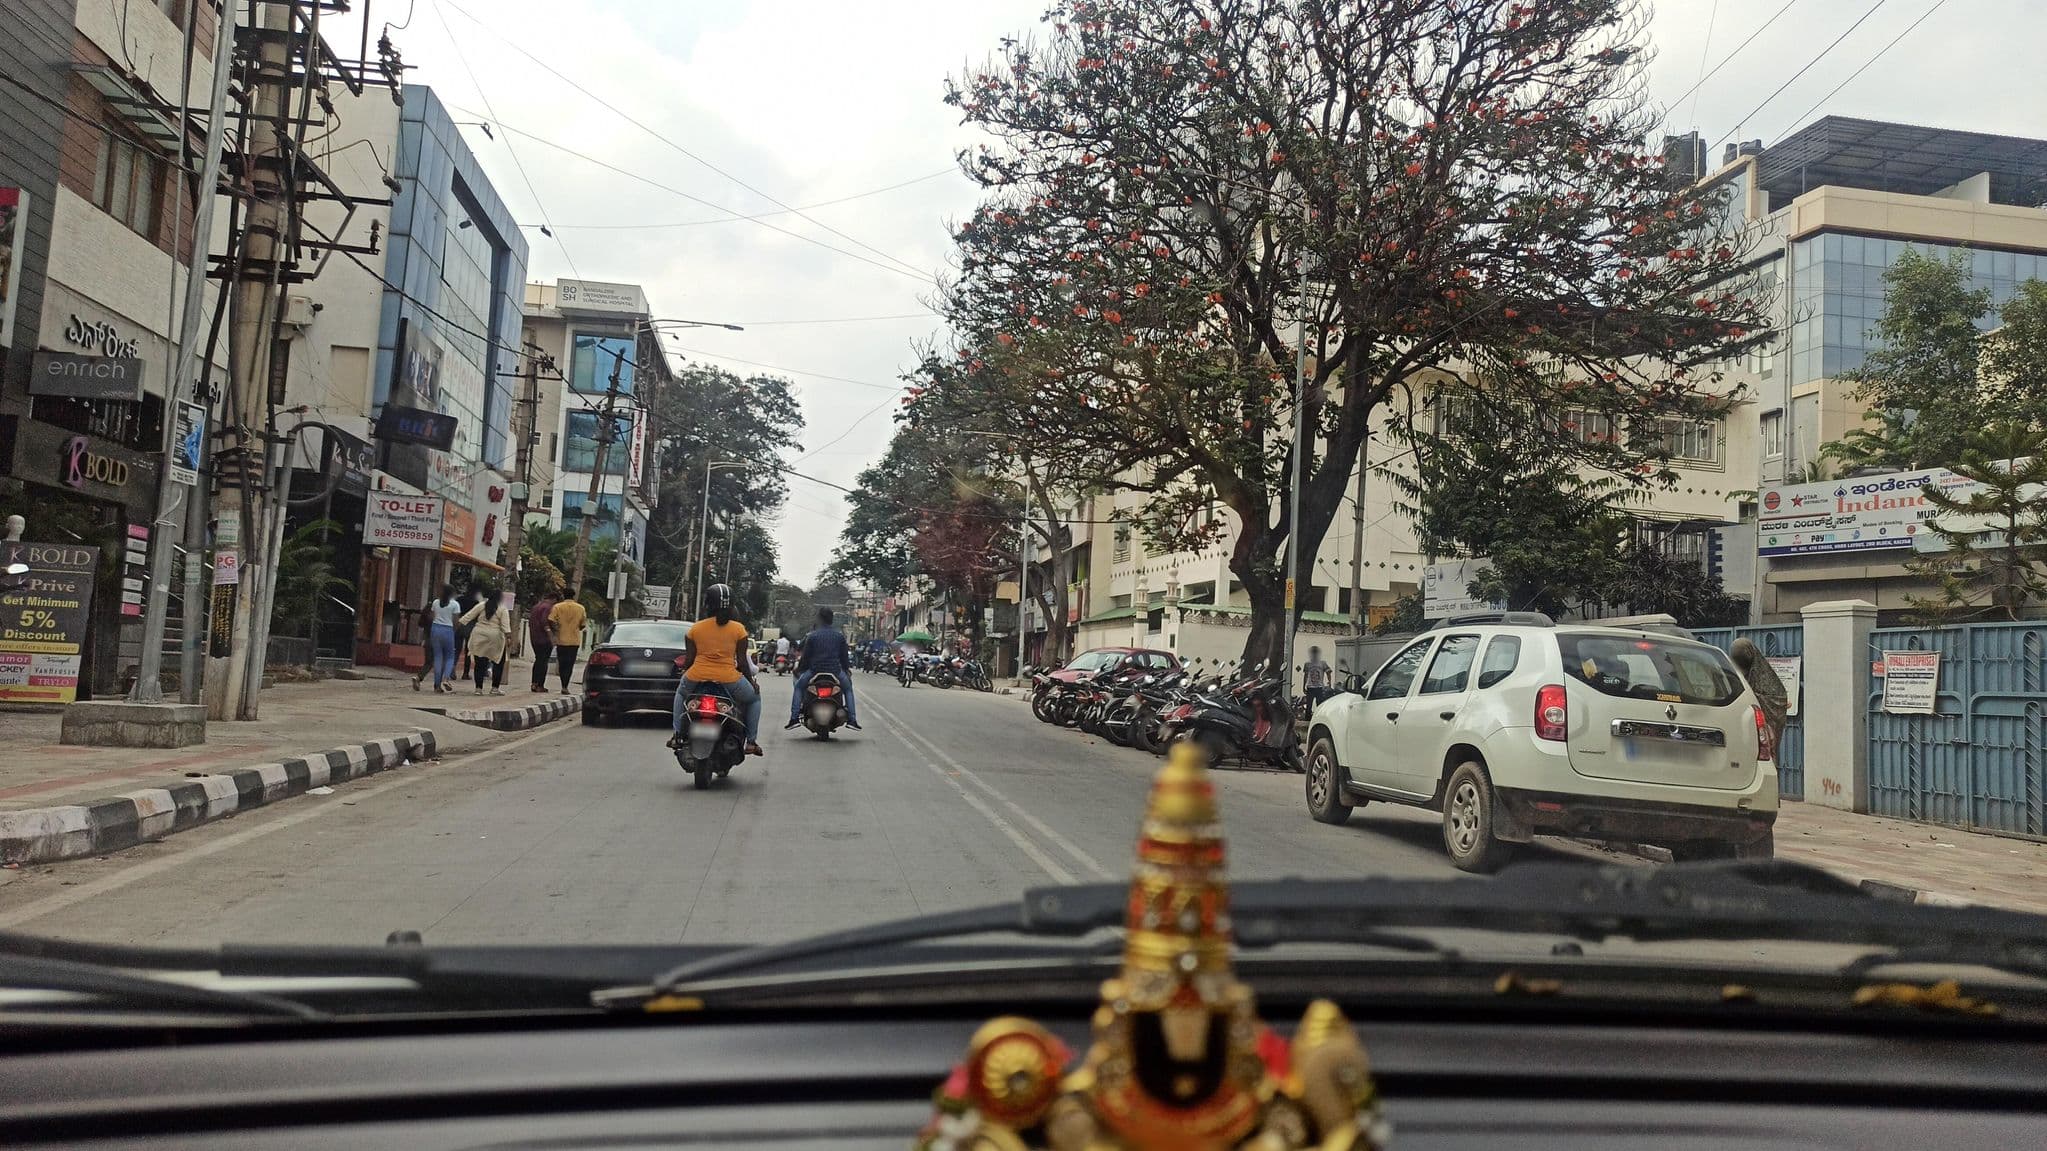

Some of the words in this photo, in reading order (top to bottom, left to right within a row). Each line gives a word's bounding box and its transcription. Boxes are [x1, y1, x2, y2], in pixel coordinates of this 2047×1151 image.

[47, 361, 125, 379] enrich
[86, 452, 129, 486] BOLD
[379, 499, 435, 514] TO-LET
[1836, 495, 1928, 513] Indane
[390, 522, 419, 530] Contact
[374, 528, 434, 540] 9845059859
[29, 547, 91, 565] BOLD
[217, 556, 235, 567] PG
[3, 595, 25, 605] Get
[27, 596, 80, 608] Minimum
[20, 610, 56, 628] 5%
[4, 628, 67, 640] Discount
